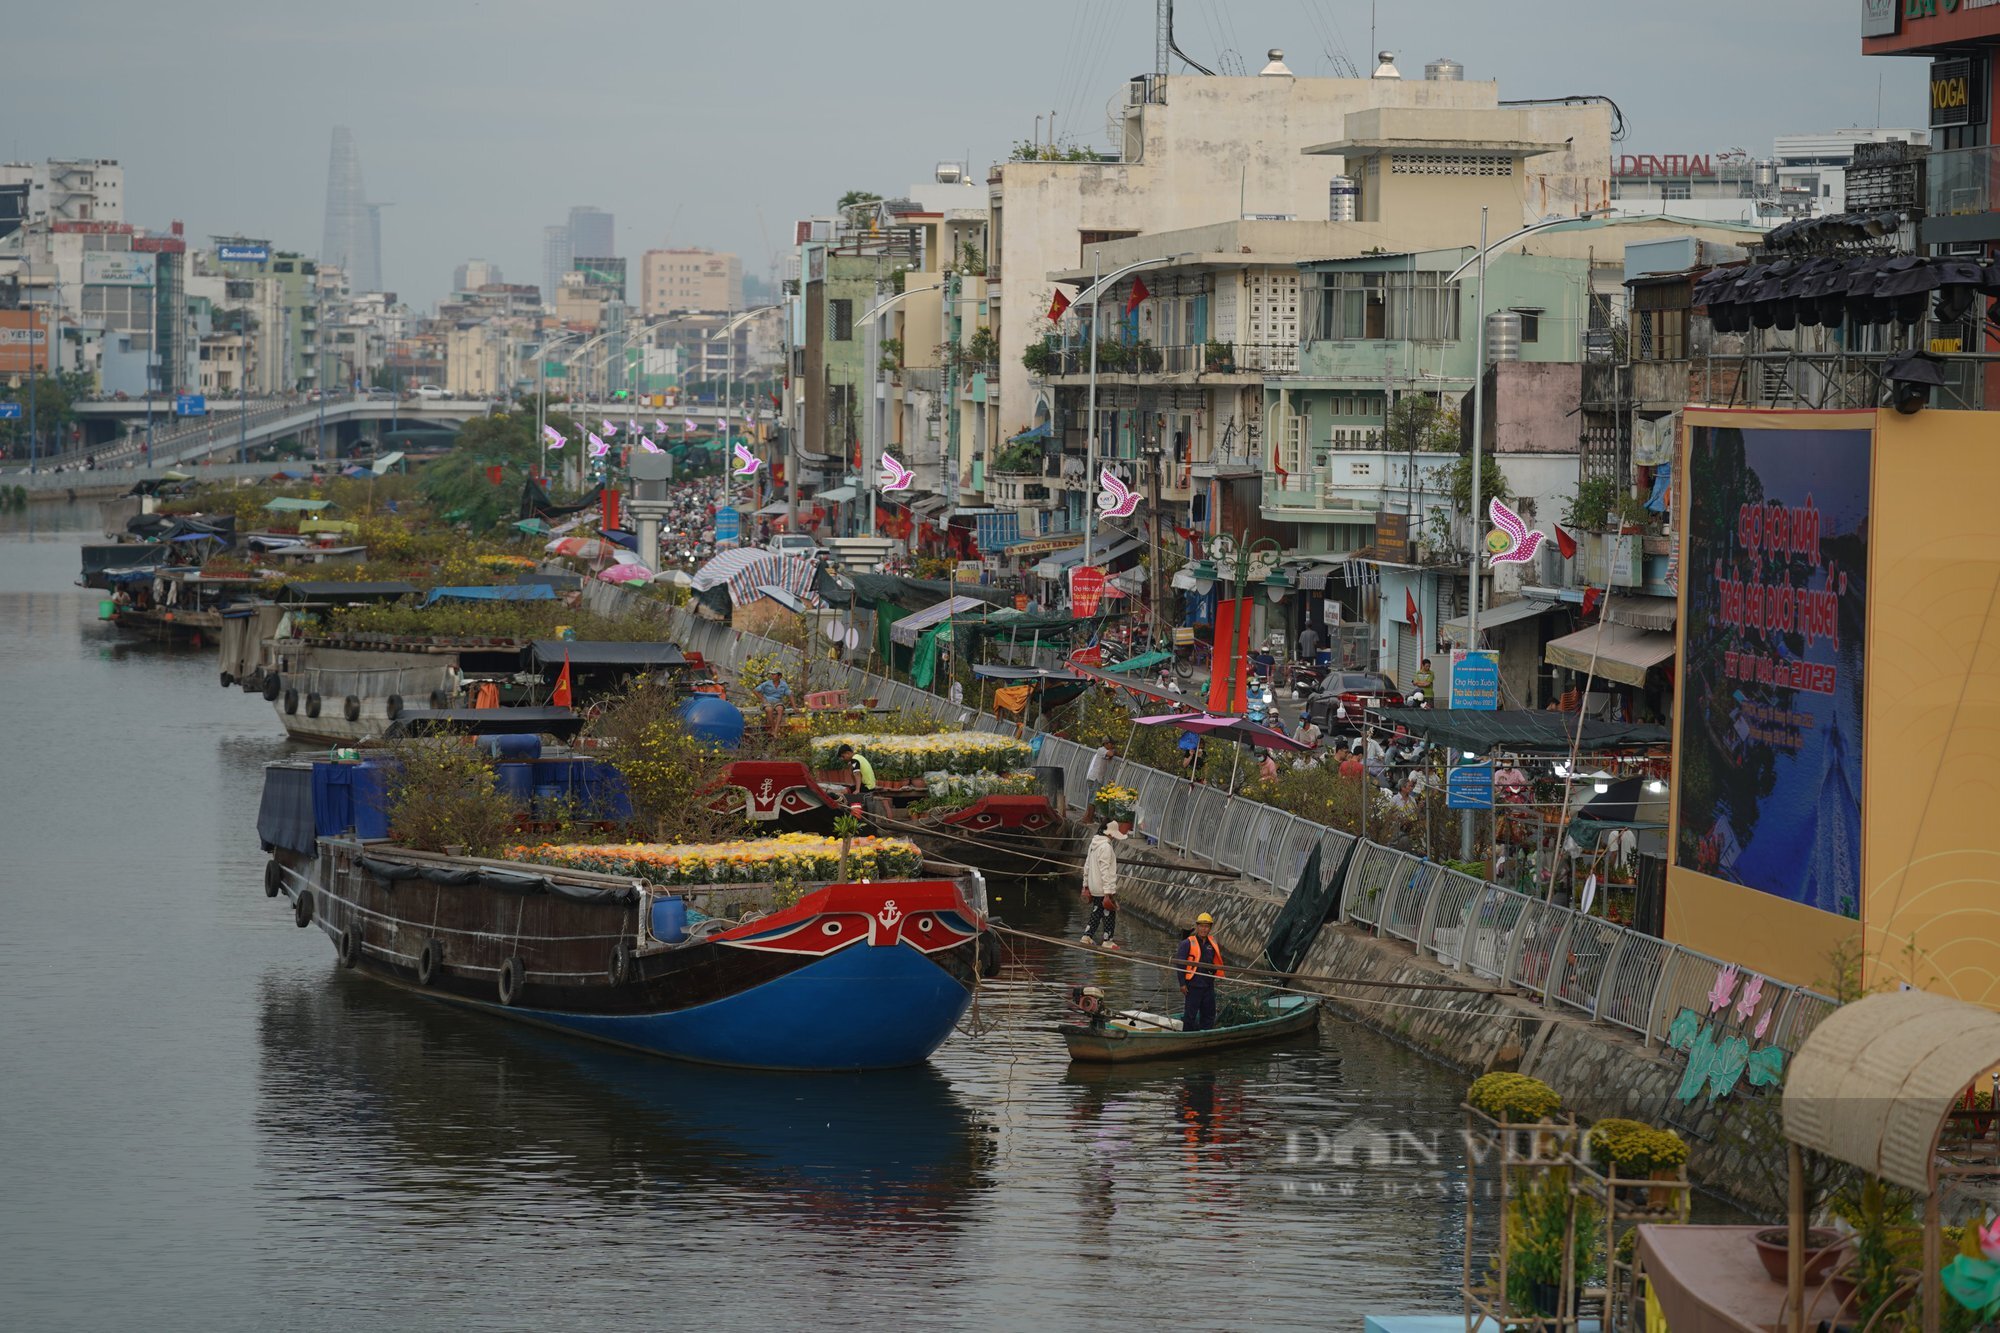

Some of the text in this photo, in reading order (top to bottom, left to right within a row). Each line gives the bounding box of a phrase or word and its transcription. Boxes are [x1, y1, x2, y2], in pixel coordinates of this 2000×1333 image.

[1931, 77, 1966, 108] YOGA
[221, 248, 266, 258] Sacombank
[1739, 492, 1821, 567] CHỢ HOA XUÂN
[1031, 542, 1050, 552] QUAY
[1746, 555, 1766, 642] BẾN
[1790, 660, 1836, 695] 2023
